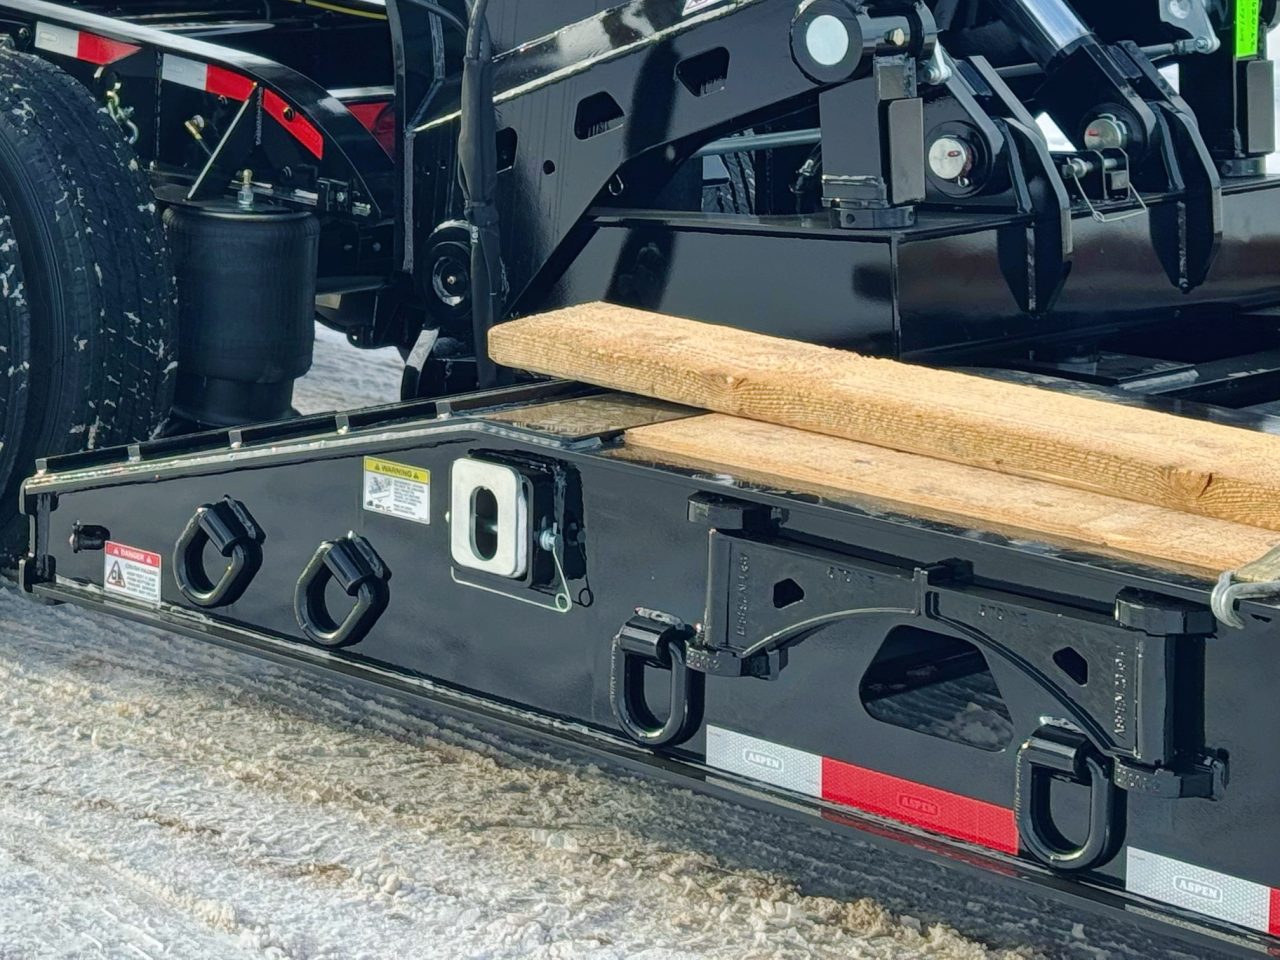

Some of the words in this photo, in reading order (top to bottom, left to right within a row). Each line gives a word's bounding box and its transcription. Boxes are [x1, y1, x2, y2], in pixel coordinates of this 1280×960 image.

[381, 464, 413, 478] WARNING
[120, 548, 145, 561] DANGER
[748, 752, 779, 768] ASPEN
[901, 796, 937, 814] ASPEN
[1180, 879, 1218, 898] ASPEN
